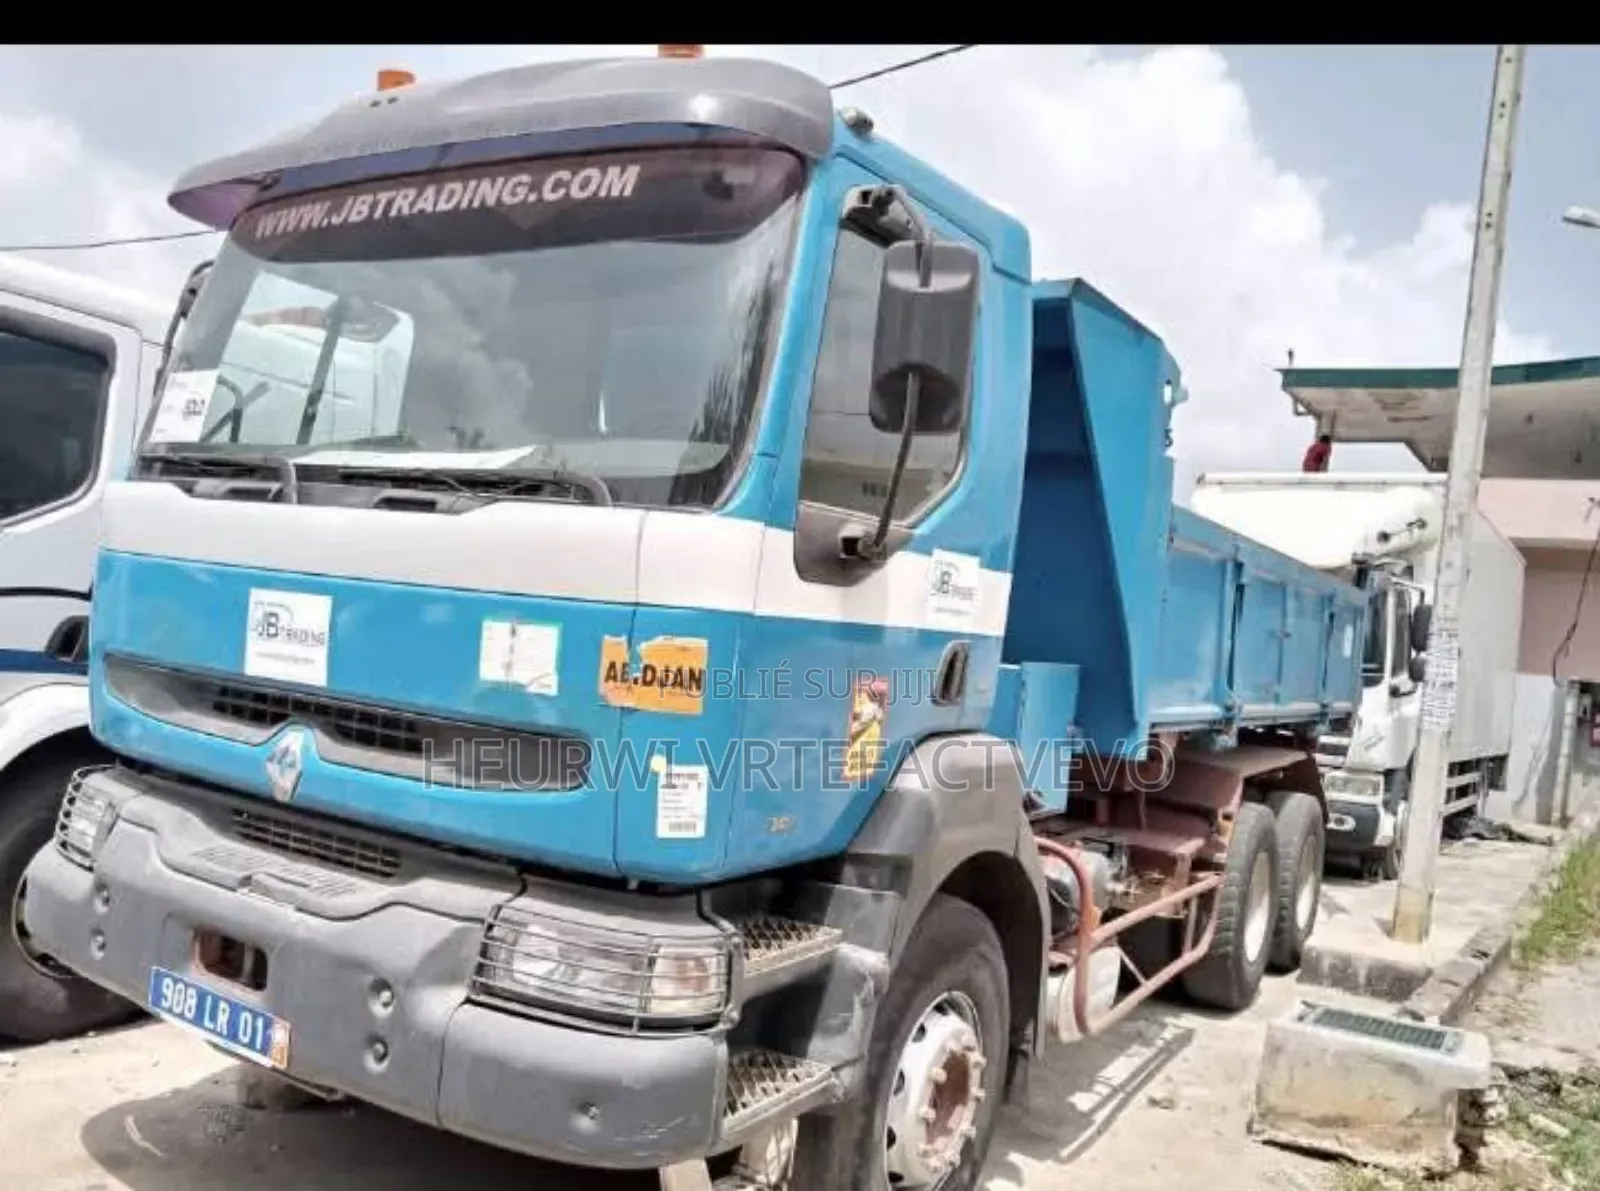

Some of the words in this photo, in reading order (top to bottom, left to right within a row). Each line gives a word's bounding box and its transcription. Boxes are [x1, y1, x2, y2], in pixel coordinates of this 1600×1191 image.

[254, 163, 641, 239] WWW.JBTRADING.COM
[162, 977, 198, 1019] 908
[204, 994, 231, 1036] LR
[239, 1011, 264, 1050] 01
